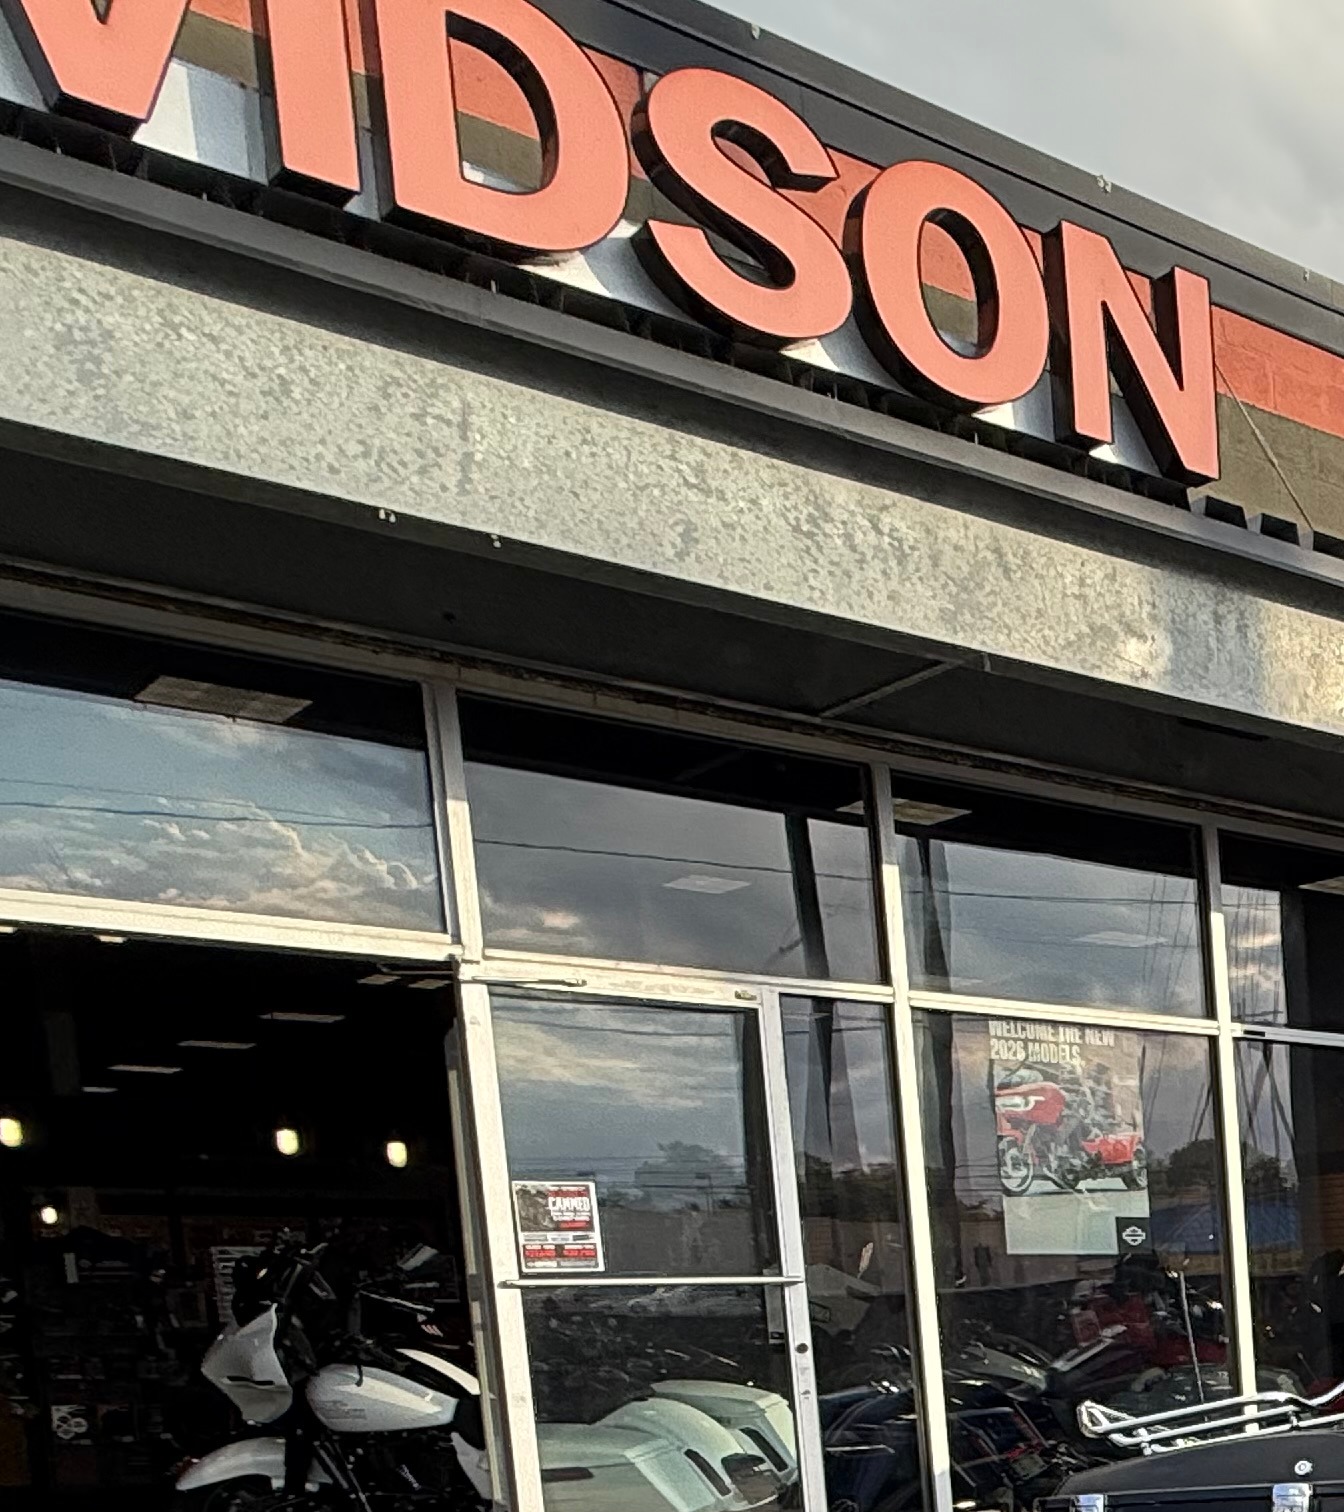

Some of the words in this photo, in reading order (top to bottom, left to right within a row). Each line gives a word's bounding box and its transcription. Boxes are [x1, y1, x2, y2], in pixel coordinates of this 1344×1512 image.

[988, 1020, 1057, 1042] WELCOME
[1058, 1025, 1083, 1044] THE
[1084, 1029, 1115, 1047] NEW
[989, 1038, 1026, 1062] 2026
